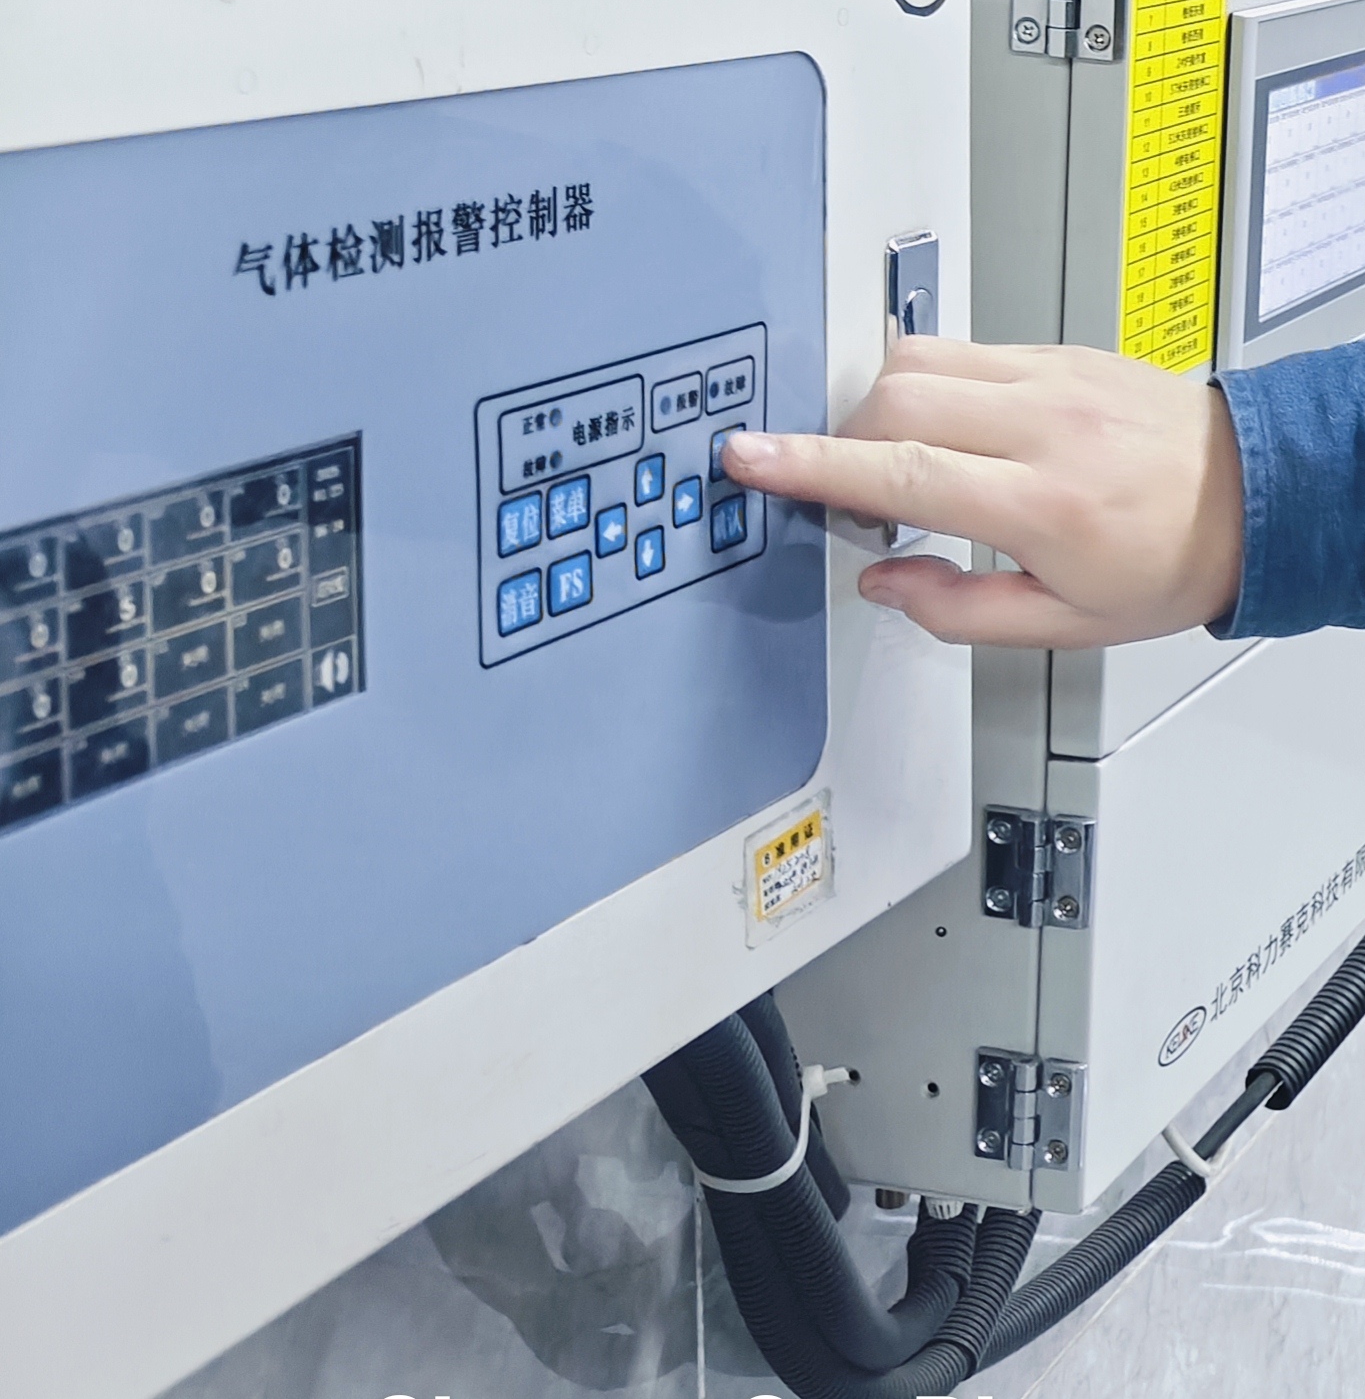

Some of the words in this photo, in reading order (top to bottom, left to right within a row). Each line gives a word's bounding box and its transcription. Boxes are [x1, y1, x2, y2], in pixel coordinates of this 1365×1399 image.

[232, 181, 596, 298] 气体检测报警控制器
[572, 406, 636, 446] 电源指示
[502, 505, 541, 548] 复位
[550, 484, 588, 531] 菜单
